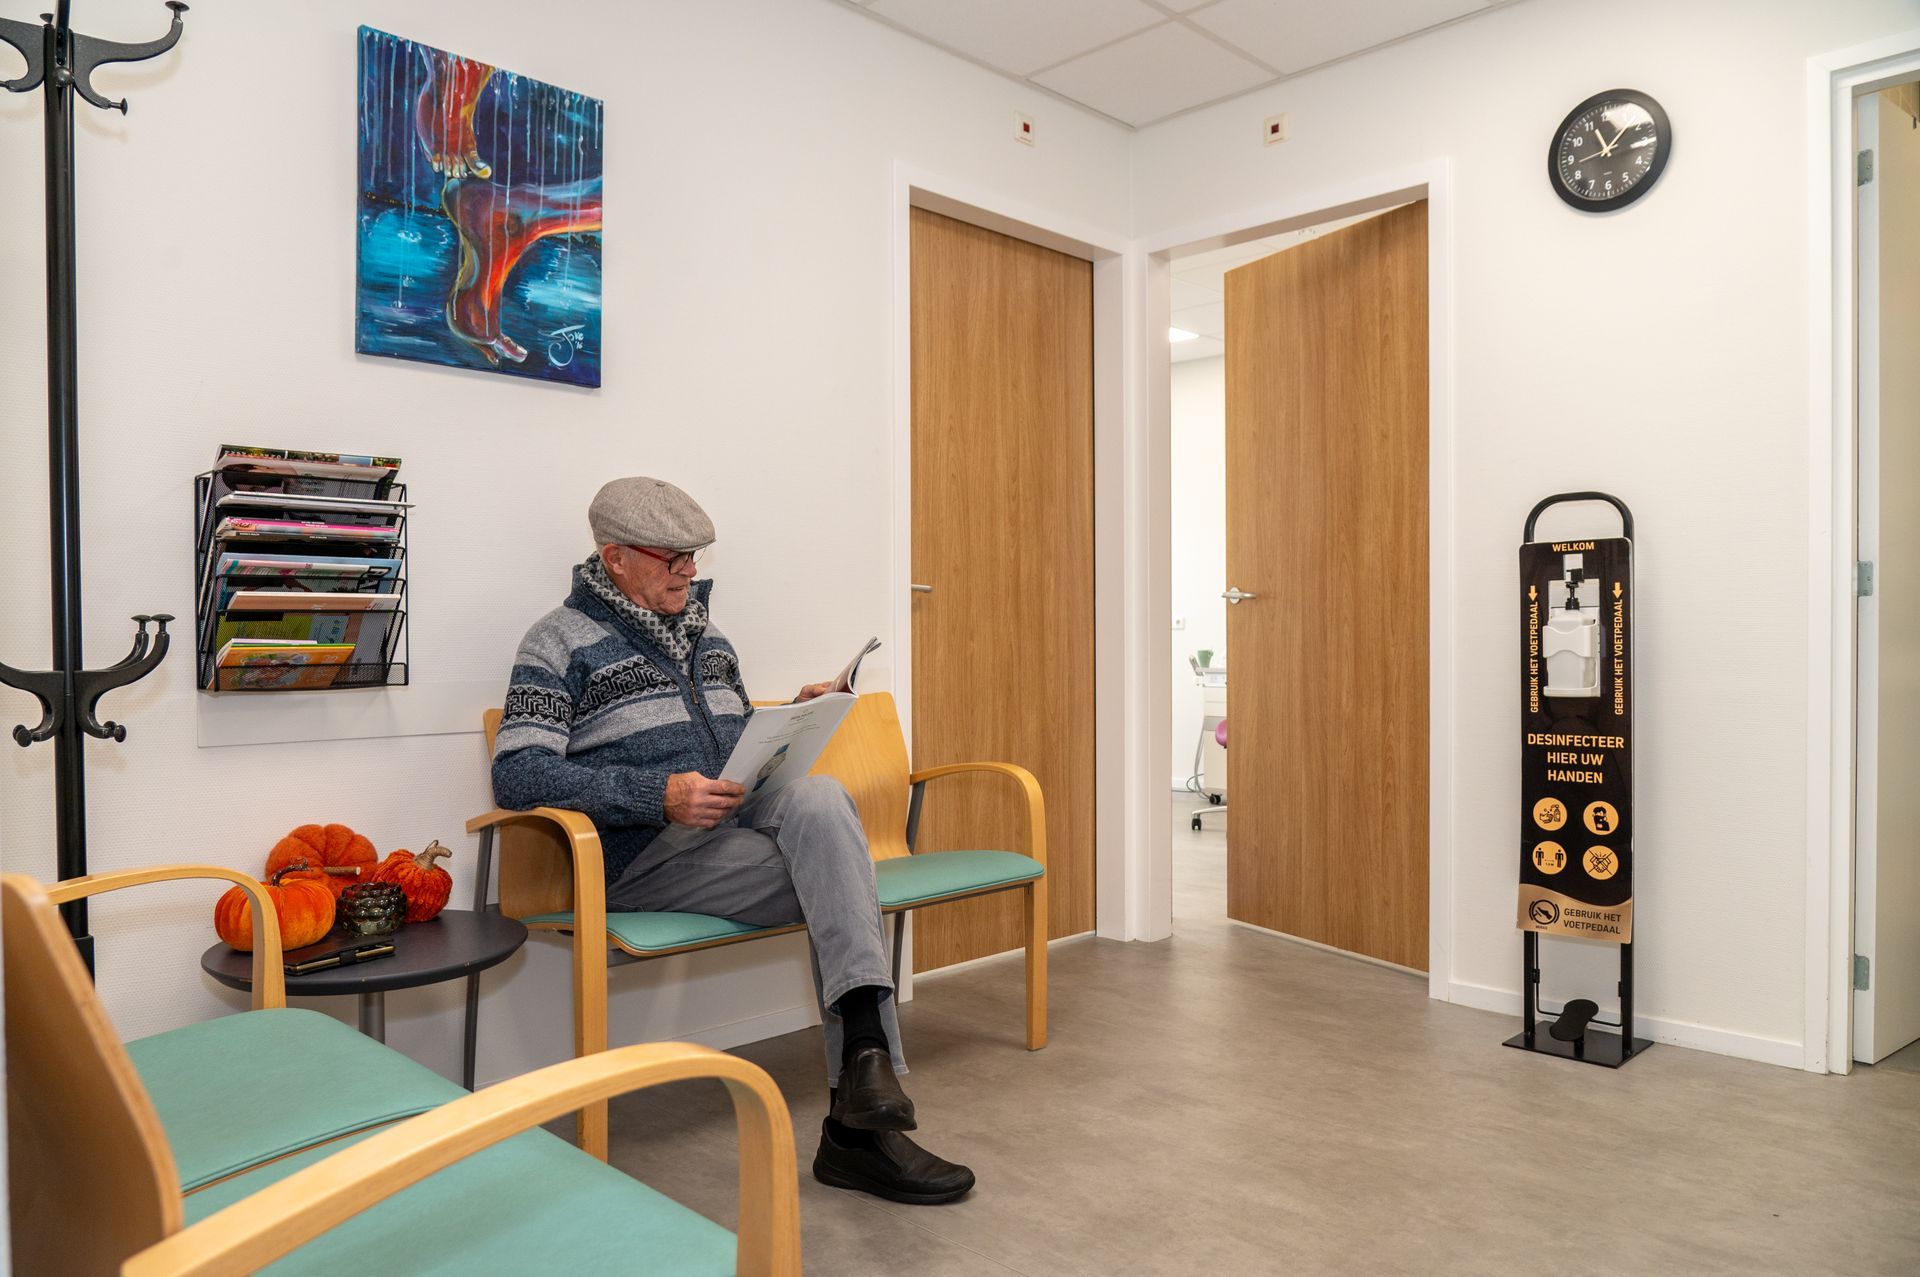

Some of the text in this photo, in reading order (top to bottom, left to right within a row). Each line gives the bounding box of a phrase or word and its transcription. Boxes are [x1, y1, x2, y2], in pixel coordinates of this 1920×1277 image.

[1584, 121, 1594, 132] 11
[1573, 136, 1583, 147] 10
[1567, 155, 1575, 165] 9
[1635, 155, 1642, 165] 4
[1574, 170, 1582, 180] 8
[1622, 172, 1629, 182] 5
[1588, 180, 1595, 190] 7
[1604, 180, 1612, 190] 6
[1552, 542, 1595, 552] WELKOM
[1529, 601, 1539, 713] GEBRUIK HET VOETPEDAAL
[1614, 599, 1624, 715] GEBRUIK HET VOETPEDAAL
[1527, 733, 1625, 748] DESINFECTEER
[1547, 752, 1604, 766] HIER UW
[1547, 769, 1603, 784] HANDEN
[1564, 908, 1621, 923] GEBRUIK HET
[1563, 920, 1621, 934] VOETPEDAAL
